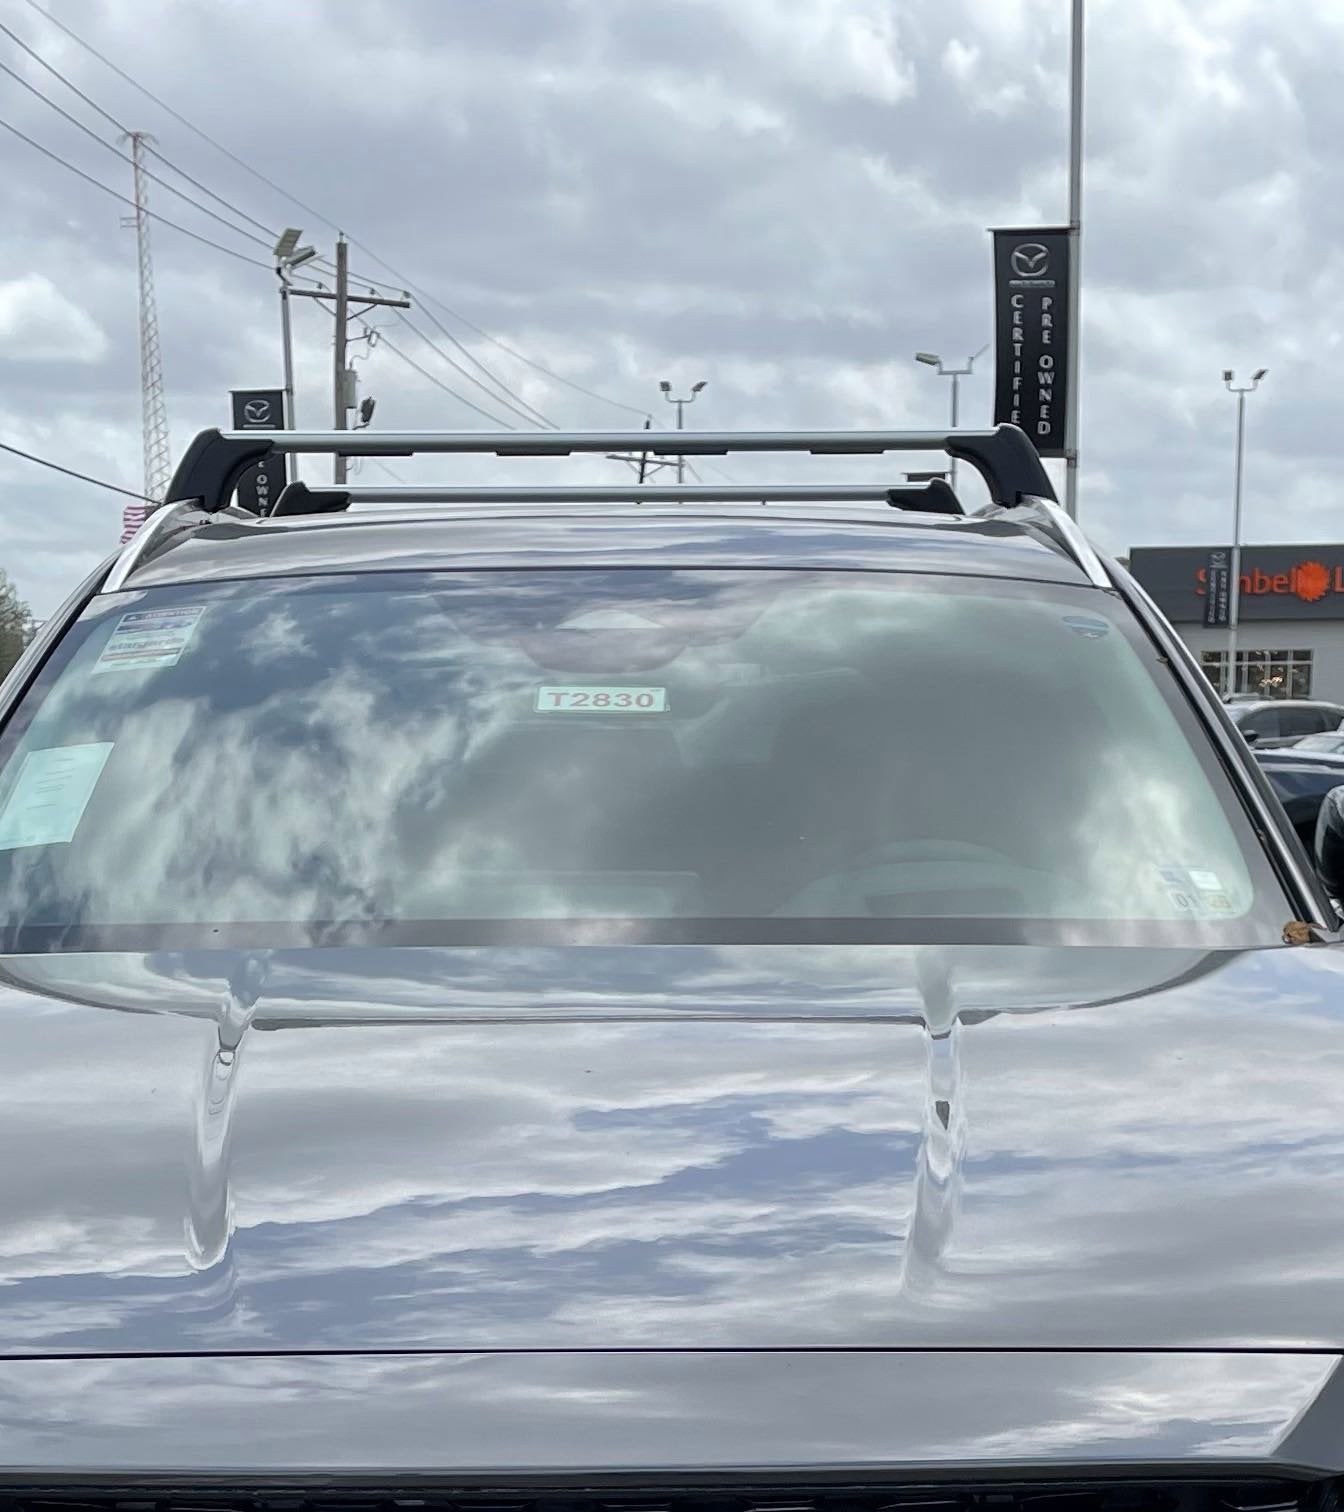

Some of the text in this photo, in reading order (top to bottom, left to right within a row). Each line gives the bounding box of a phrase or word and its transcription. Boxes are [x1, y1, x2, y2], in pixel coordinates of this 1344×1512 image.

[1010, 294, 1025, 425] CERTIFIE
[1036, 296, 1056, 436] PRE OWNED
[256, 474, 269, 518] OWNE
[547, 692, 655, 708] T2830
